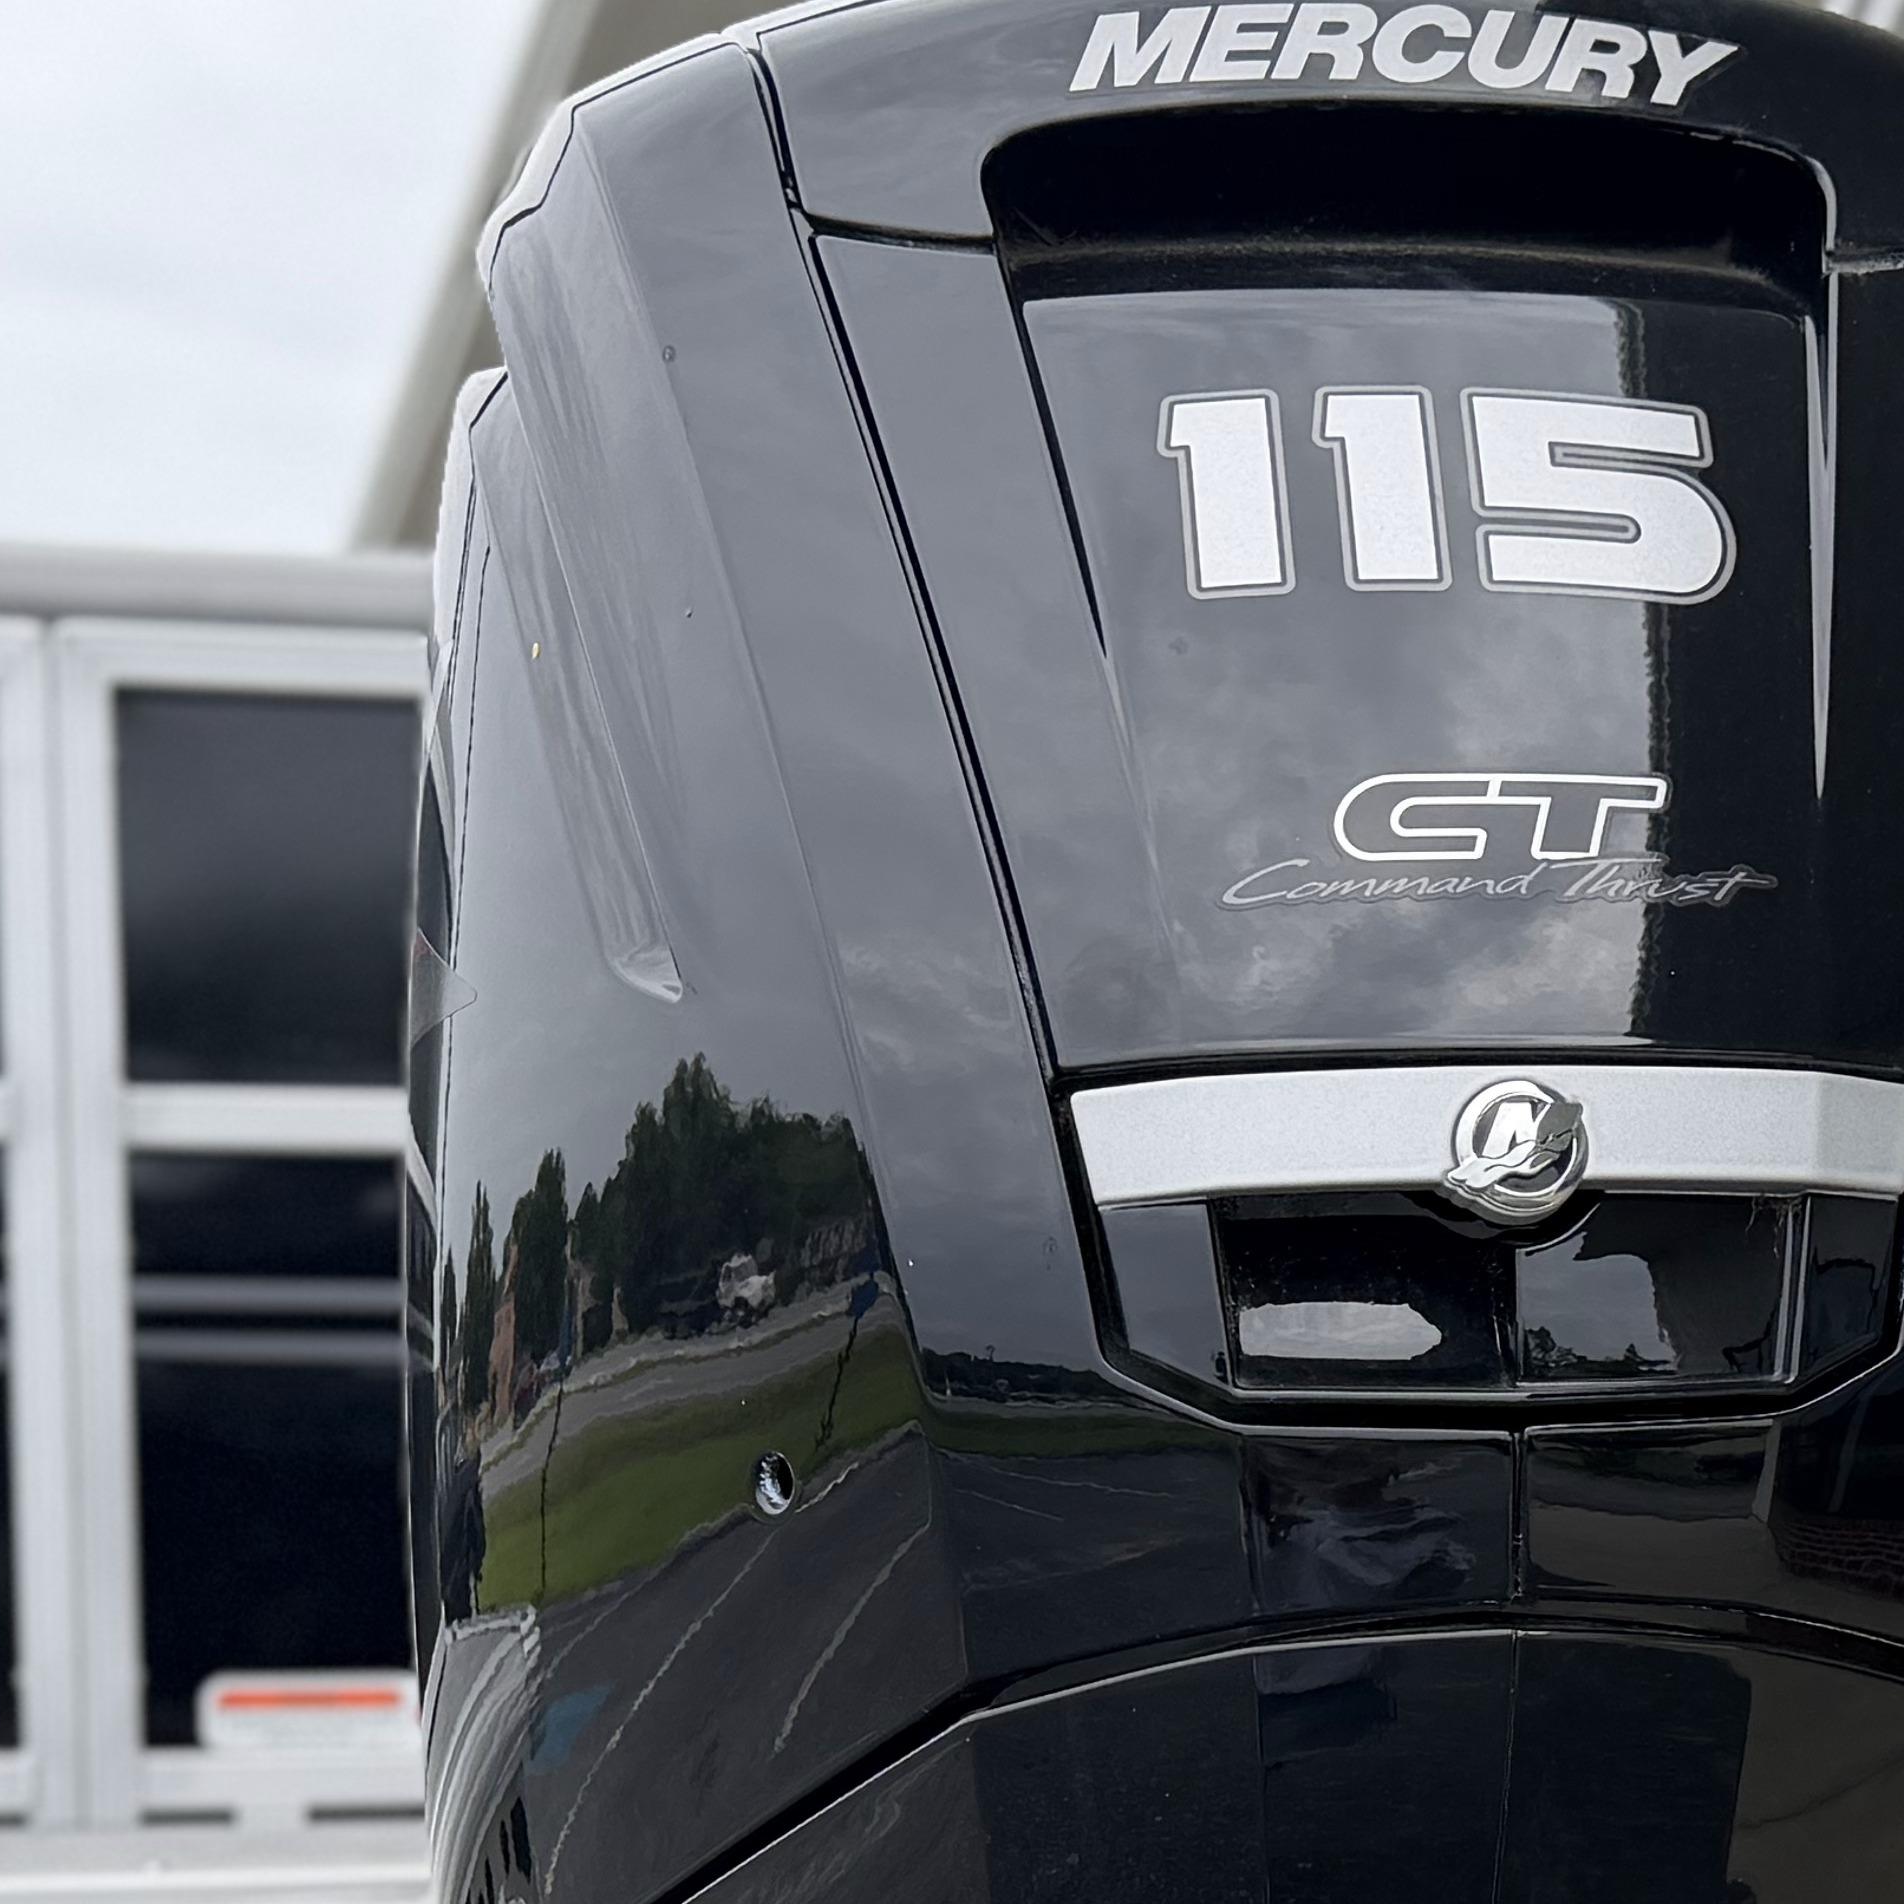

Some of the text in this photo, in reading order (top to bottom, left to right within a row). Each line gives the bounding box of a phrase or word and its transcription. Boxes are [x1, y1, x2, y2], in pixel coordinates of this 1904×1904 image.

[1069, 2, 1741, 106] MERCURY
[1157, 385, 1737, 605] 115
[1332, 772, 1668, 862] GT
[1219, 856, 1778, 905] Command Thrust
